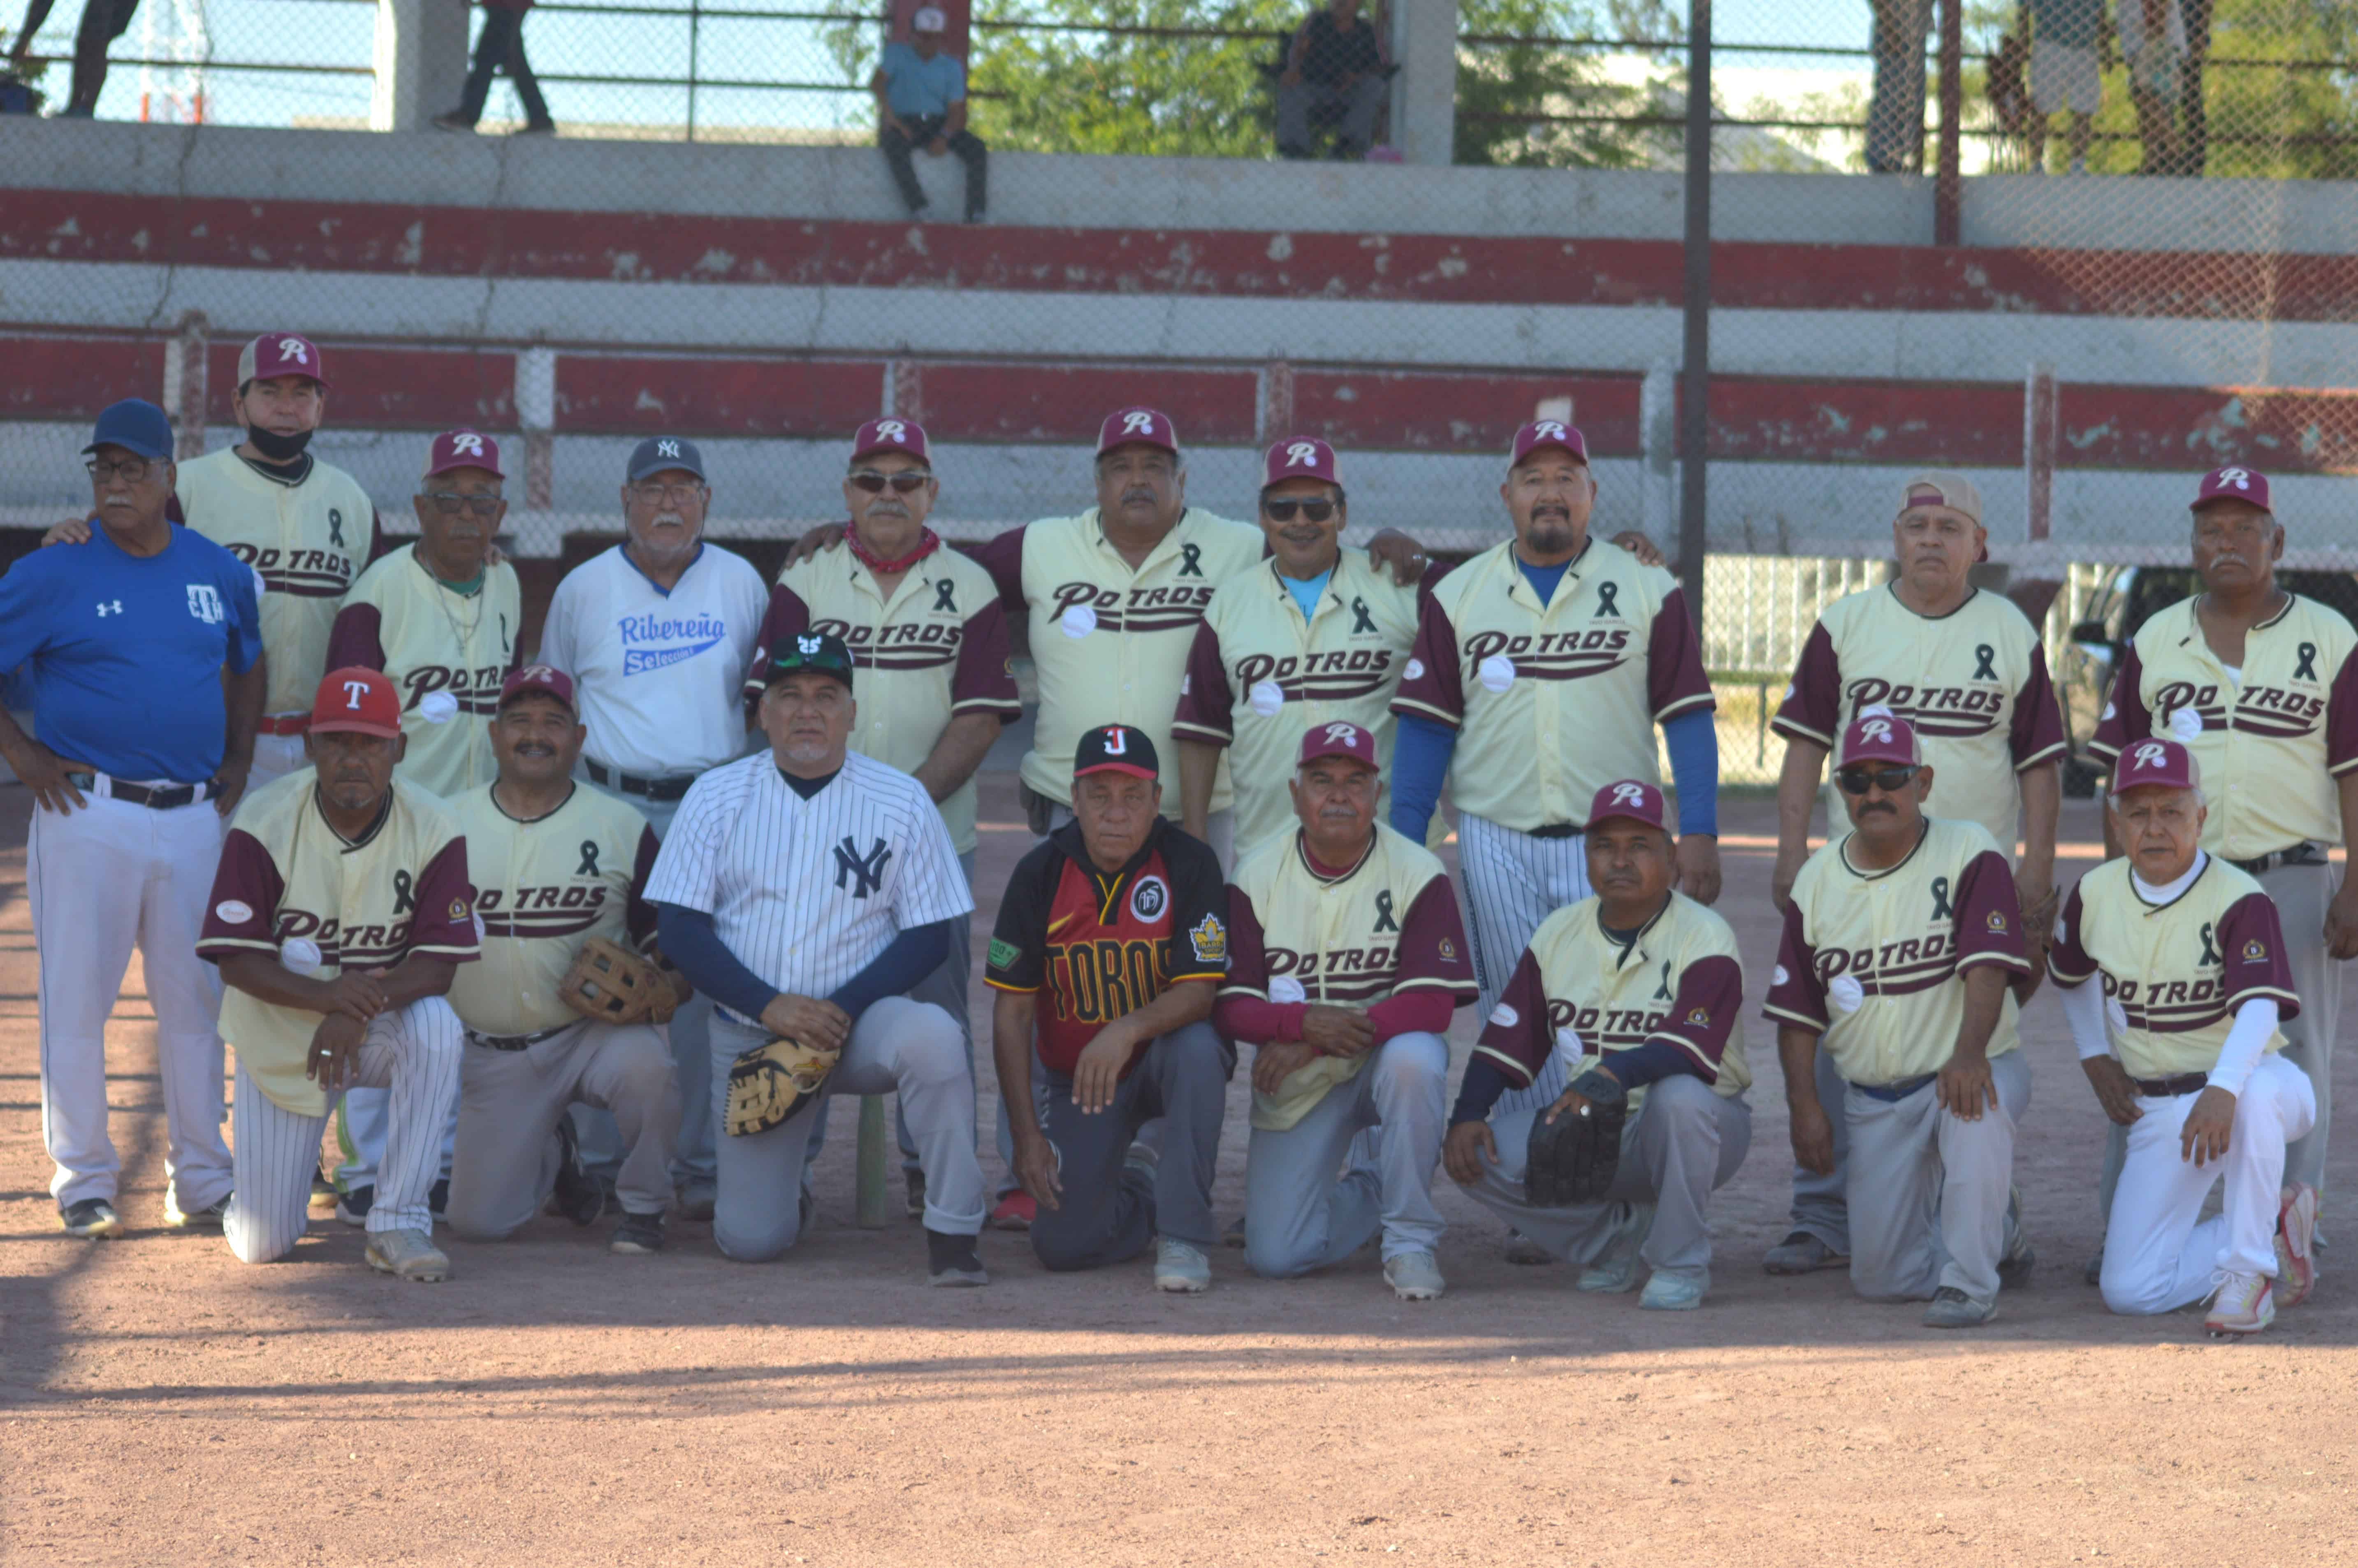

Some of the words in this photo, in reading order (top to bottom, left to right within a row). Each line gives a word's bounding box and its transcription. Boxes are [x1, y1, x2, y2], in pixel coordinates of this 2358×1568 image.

[279, 338, 304, 361] P
[875, 420, 904, 442] P
[1122, 412, 1151, 434] P
[1533, 420, 1563, 442] P
[453, 434, 482, 455] P
[658, 441, 679, 458] NY
[1285, 443, 1315, 467] P
[2216, 468, 2248, 489] P
[1047, 582, 1215, 624] POTROS
[617, 612, 726, 645] Ribereña
[1463, 630, 1630, 682] POTROS
[1236, 650, 1392, 705] POTROS
[344, 681, 370, 709] T
[1847, 678, 2004, 721] POTROS
[2154, 682, 2325, 728] POTROS
[1324, 724, 1356, 745] P
[1859, 720, 1890, 744] P
[2132, 744, 2164, 771] P
[1610, 783, 1642, 806] P
[832, 835, 892, 899] NY
